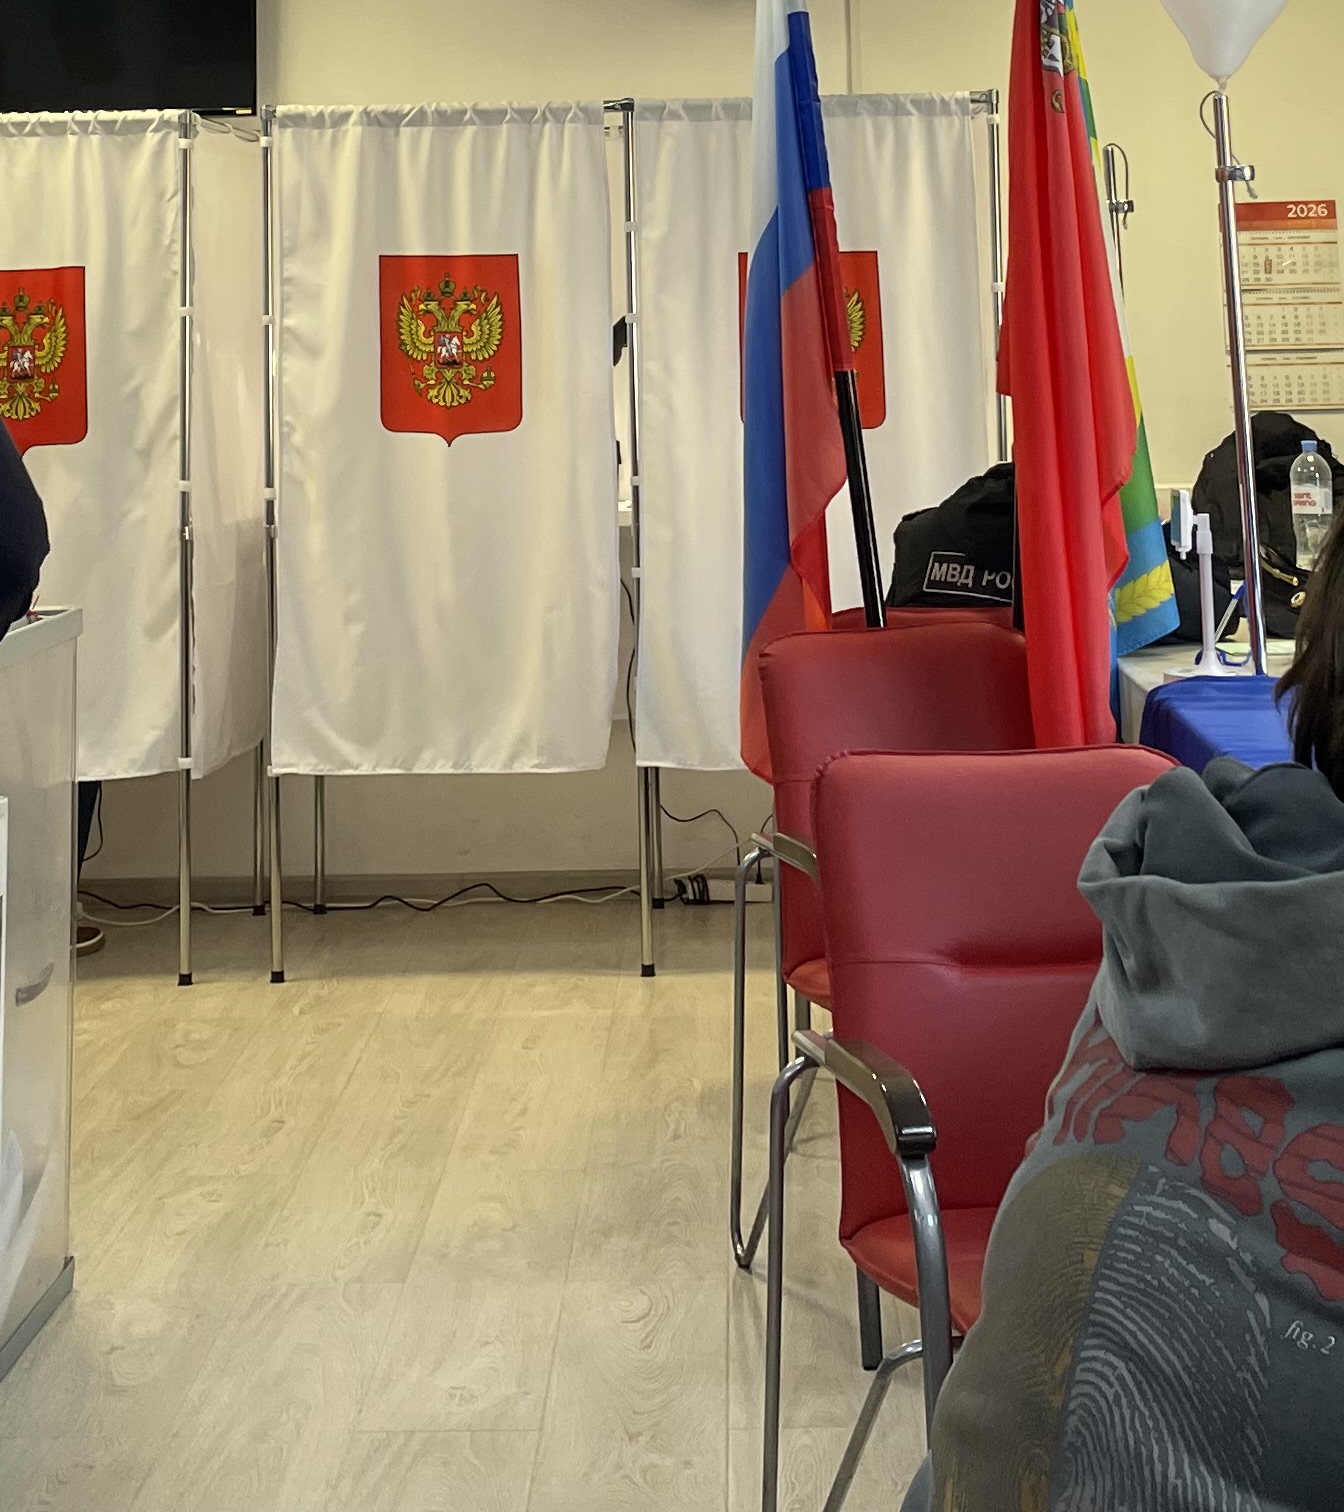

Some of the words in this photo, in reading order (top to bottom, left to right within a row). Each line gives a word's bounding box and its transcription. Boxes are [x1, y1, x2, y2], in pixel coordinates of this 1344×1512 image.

[1286, 203, 1329, 218] 2026
[930, 562, 975, 588] МВД
[981, 569, 1012, 590] РО
